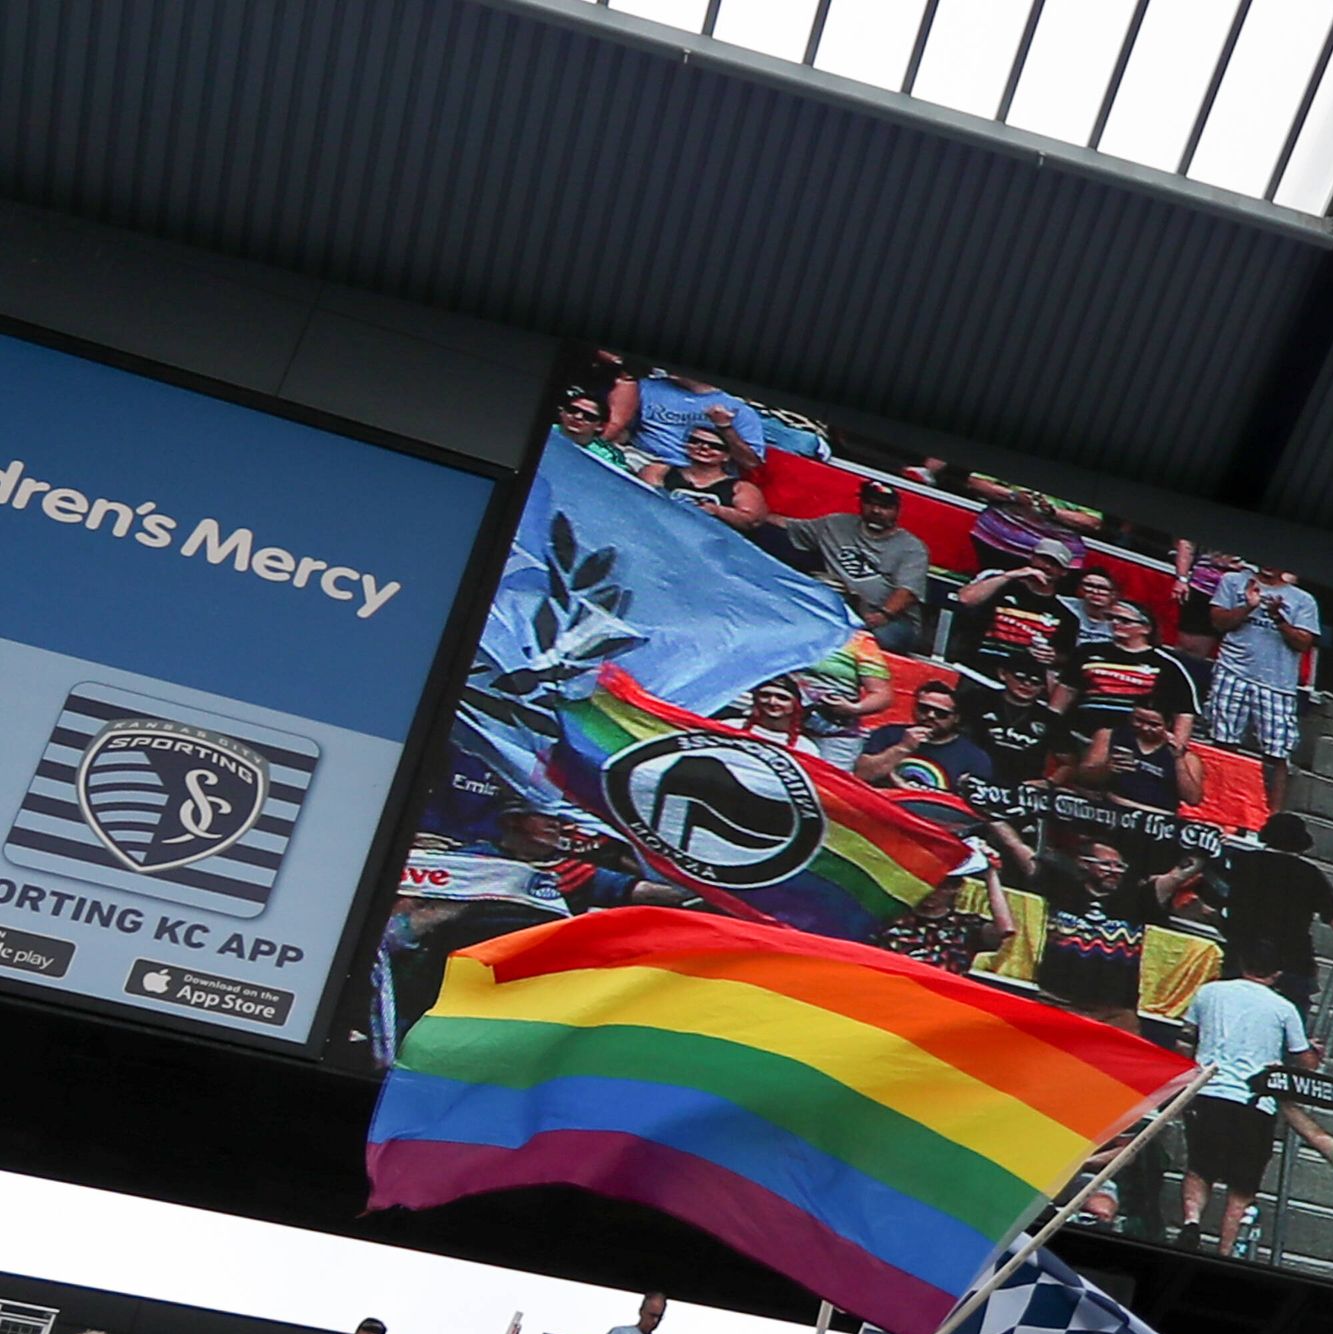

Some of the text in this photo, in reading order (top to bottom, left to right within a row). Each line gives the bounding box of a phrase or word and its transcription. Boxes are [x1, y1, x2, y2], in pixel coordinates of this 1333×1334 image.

[180, 518, 400, 619] Mercy
[113, 721, 207, 738] KANSAS
[107, 736, 254, 785] SPORTING
[153, 915, 210, 949] KC
[216, 933, 304, 969] APP
[13, 950, 55, 970] play
[176, 985, 276, 1019] App Store
[183, 973, 280, 1002] Download on the
